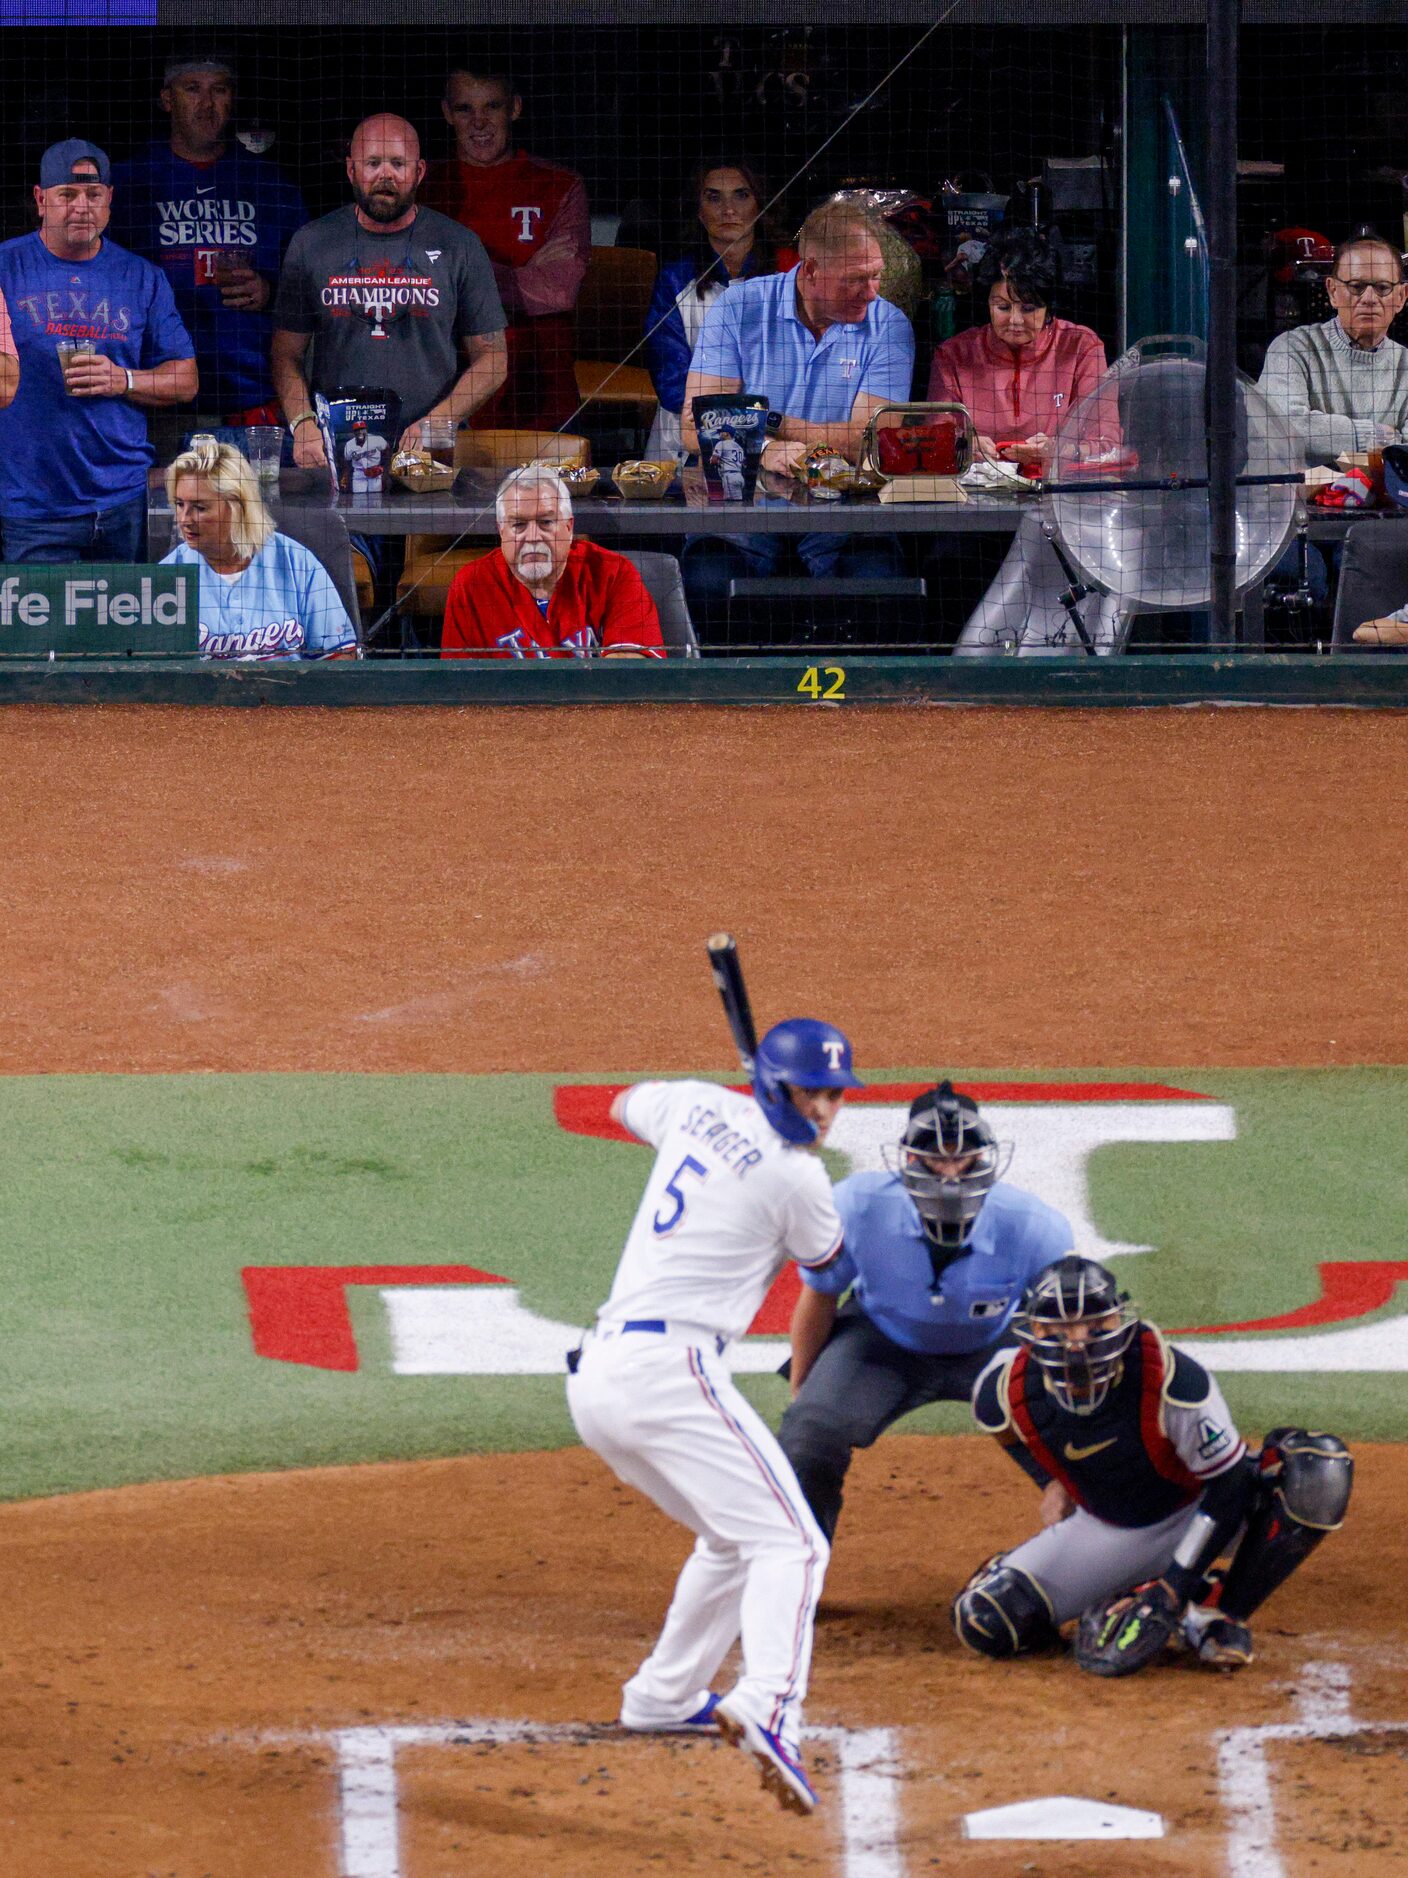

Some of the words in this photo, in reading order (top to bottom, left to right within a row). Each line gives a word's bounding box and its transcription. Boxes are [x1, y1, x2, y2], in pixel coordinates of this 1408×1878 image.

[156, 199, 256, 221] WORLD
[159, 221, 257, 246] SERIES
[511, 206, 541, 241] T
[1296, 237, 1315, 257] T
[197, 250, 220, 278] T
[330, 277, 386, 286] AMERICAN
[387, 277, 430, 286] LEAGUE
[320, 287, 441, 307] CHAMPIONS
[16, 290, 132, 333] TEXAS
[363, 301, 393, 338] T
[45, 322, 108, 340] BASEBALL
[839, 358, 857, 379] T
[345, 403, 387, 411] STRAIGHT
[1053, 393, 1064, 408] T
[345, 410, 357, 421] UP
[700, 410, 760, 430] Rangers
[65, 576, 187, 626] Field
[797, 667, 846, 699] 42
[822, 1041, 844, 1070] T
[680, 1104, 763, 1181] SEAGER
[651, 1154, 710, 1241] 5
